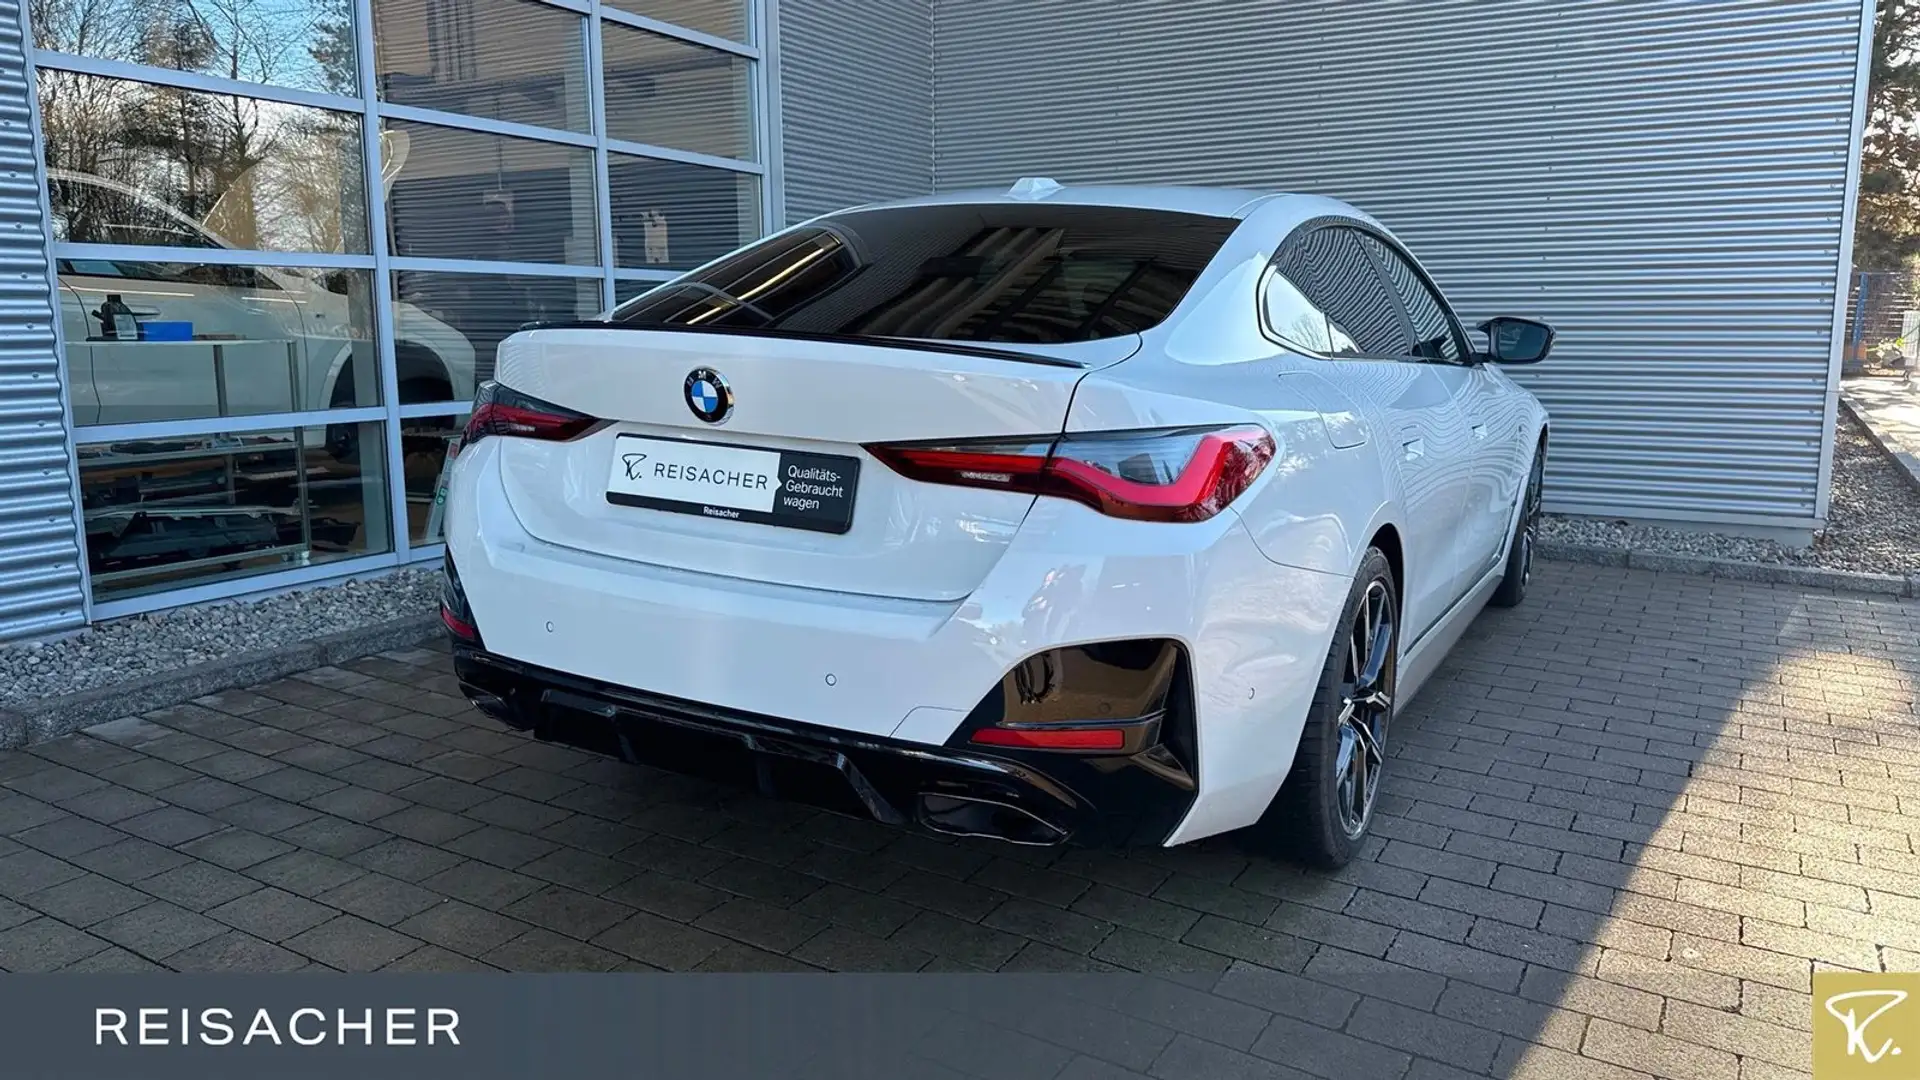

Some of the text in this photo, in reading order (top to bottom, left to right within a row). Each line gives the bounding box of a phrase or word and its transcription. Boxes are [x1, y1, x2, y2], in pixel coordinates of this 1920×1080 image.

[653, 462, 768, 490] REISACHER
[787, 464, 841, 483] Qualitäts-
[785, 480, 843, 498] Gebraucht
[703, 506, 740, 519] Reisacher
[783, 496, 820, 511] wagen
